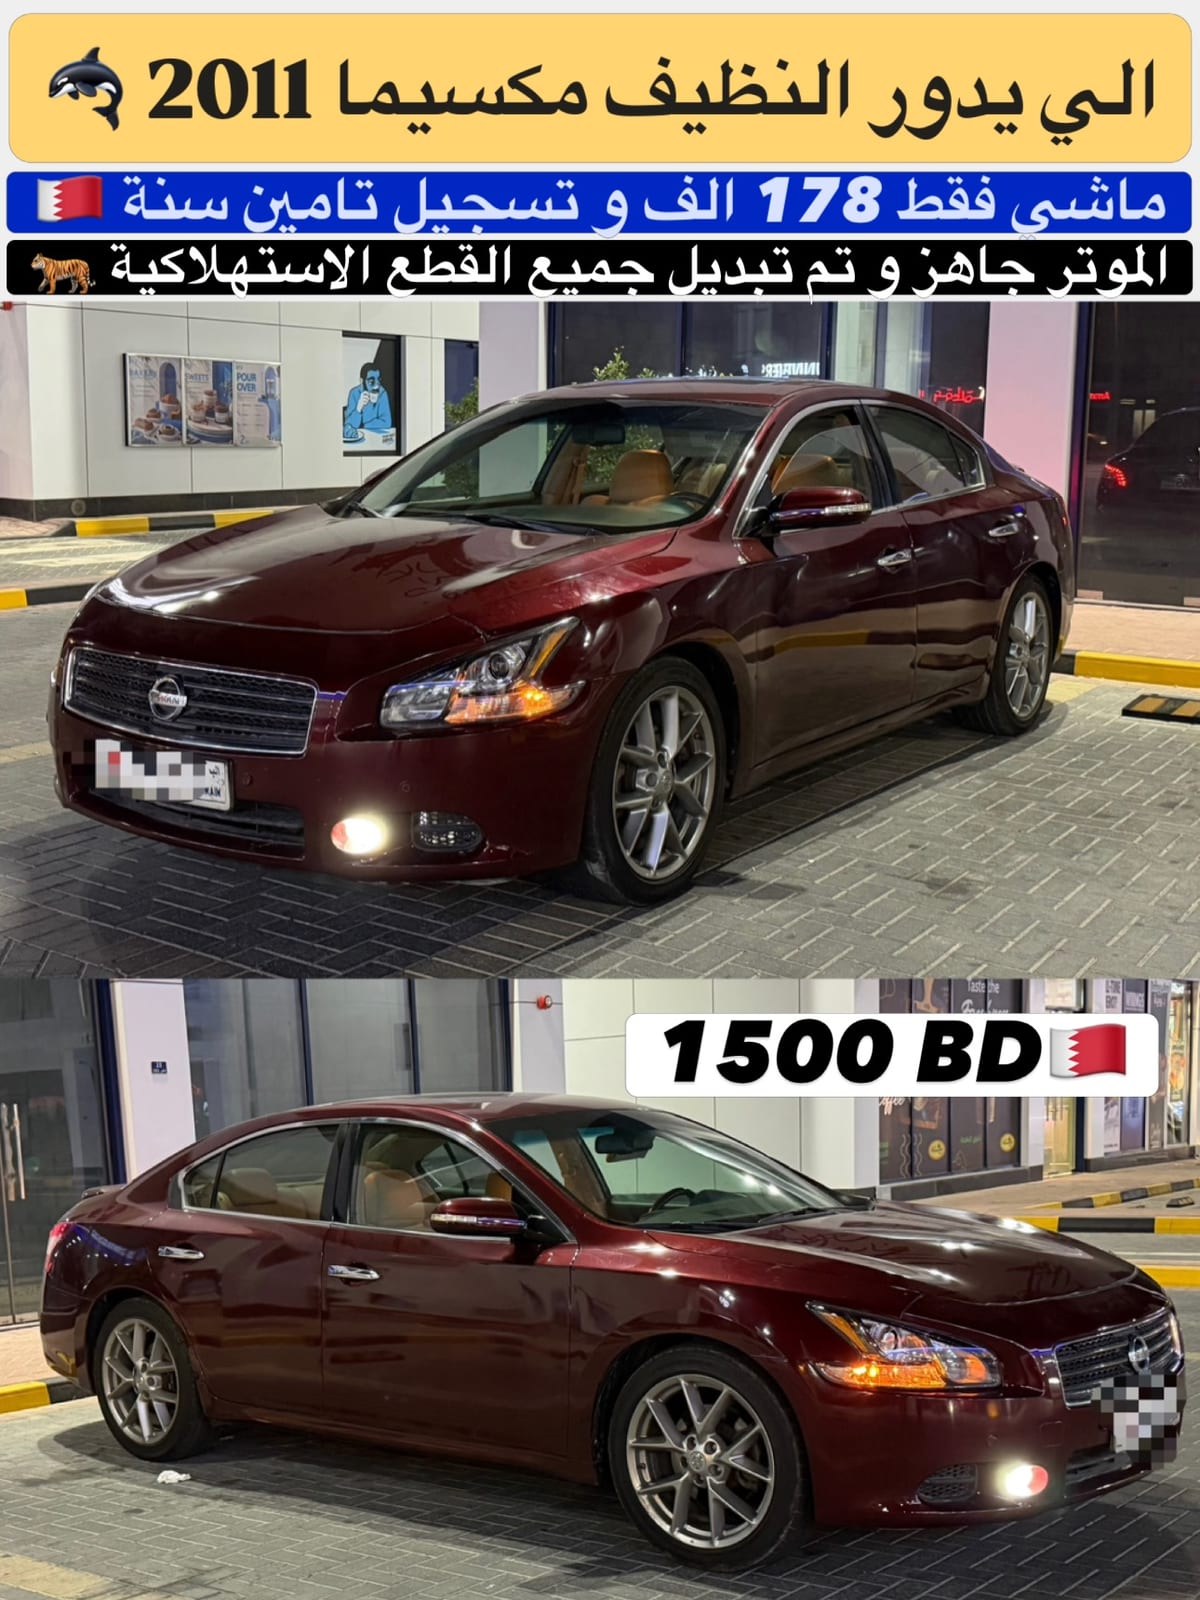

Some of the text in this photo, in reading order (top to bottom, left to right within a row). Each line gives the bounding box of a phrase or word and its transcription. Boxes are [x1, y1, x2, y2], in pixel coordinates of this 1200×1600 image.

[236, 373, 256, 382] POUR
[236, 382, 256, 393] OVER
[966, 977, 1000, 994] Taste the
